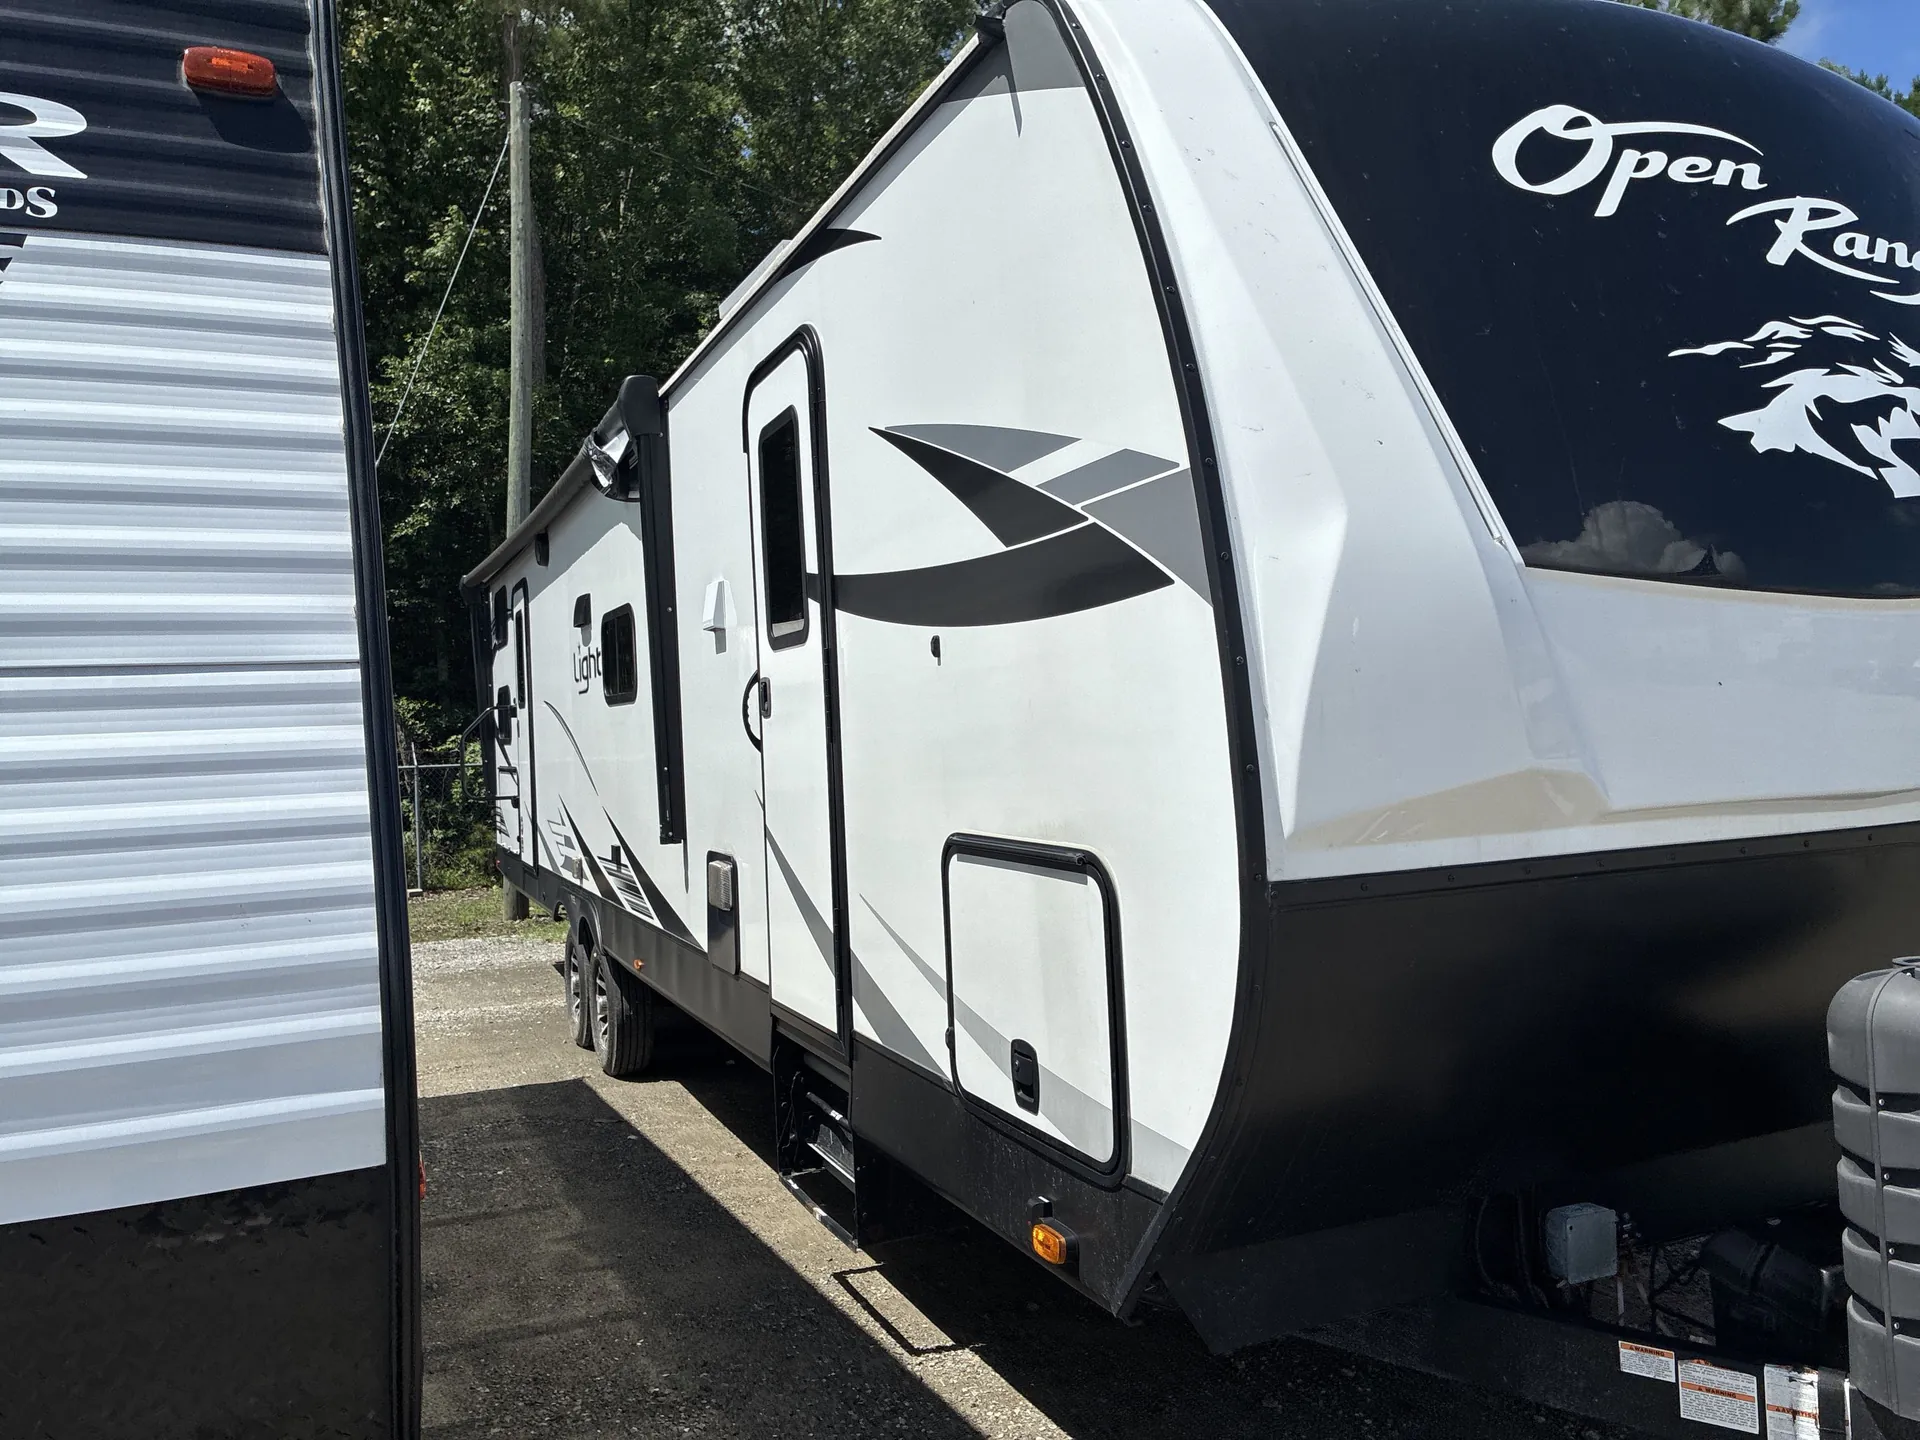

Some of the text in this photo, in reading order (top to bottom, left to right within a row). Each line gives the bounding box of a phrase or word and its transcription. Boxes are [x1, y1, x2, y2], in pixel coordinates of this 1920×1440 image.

[1491, 104, 1769, 218] Open
[1634, 1345, 1665, 1357] WARNING
[1705, 1387, 1737, 1399] WARNING
